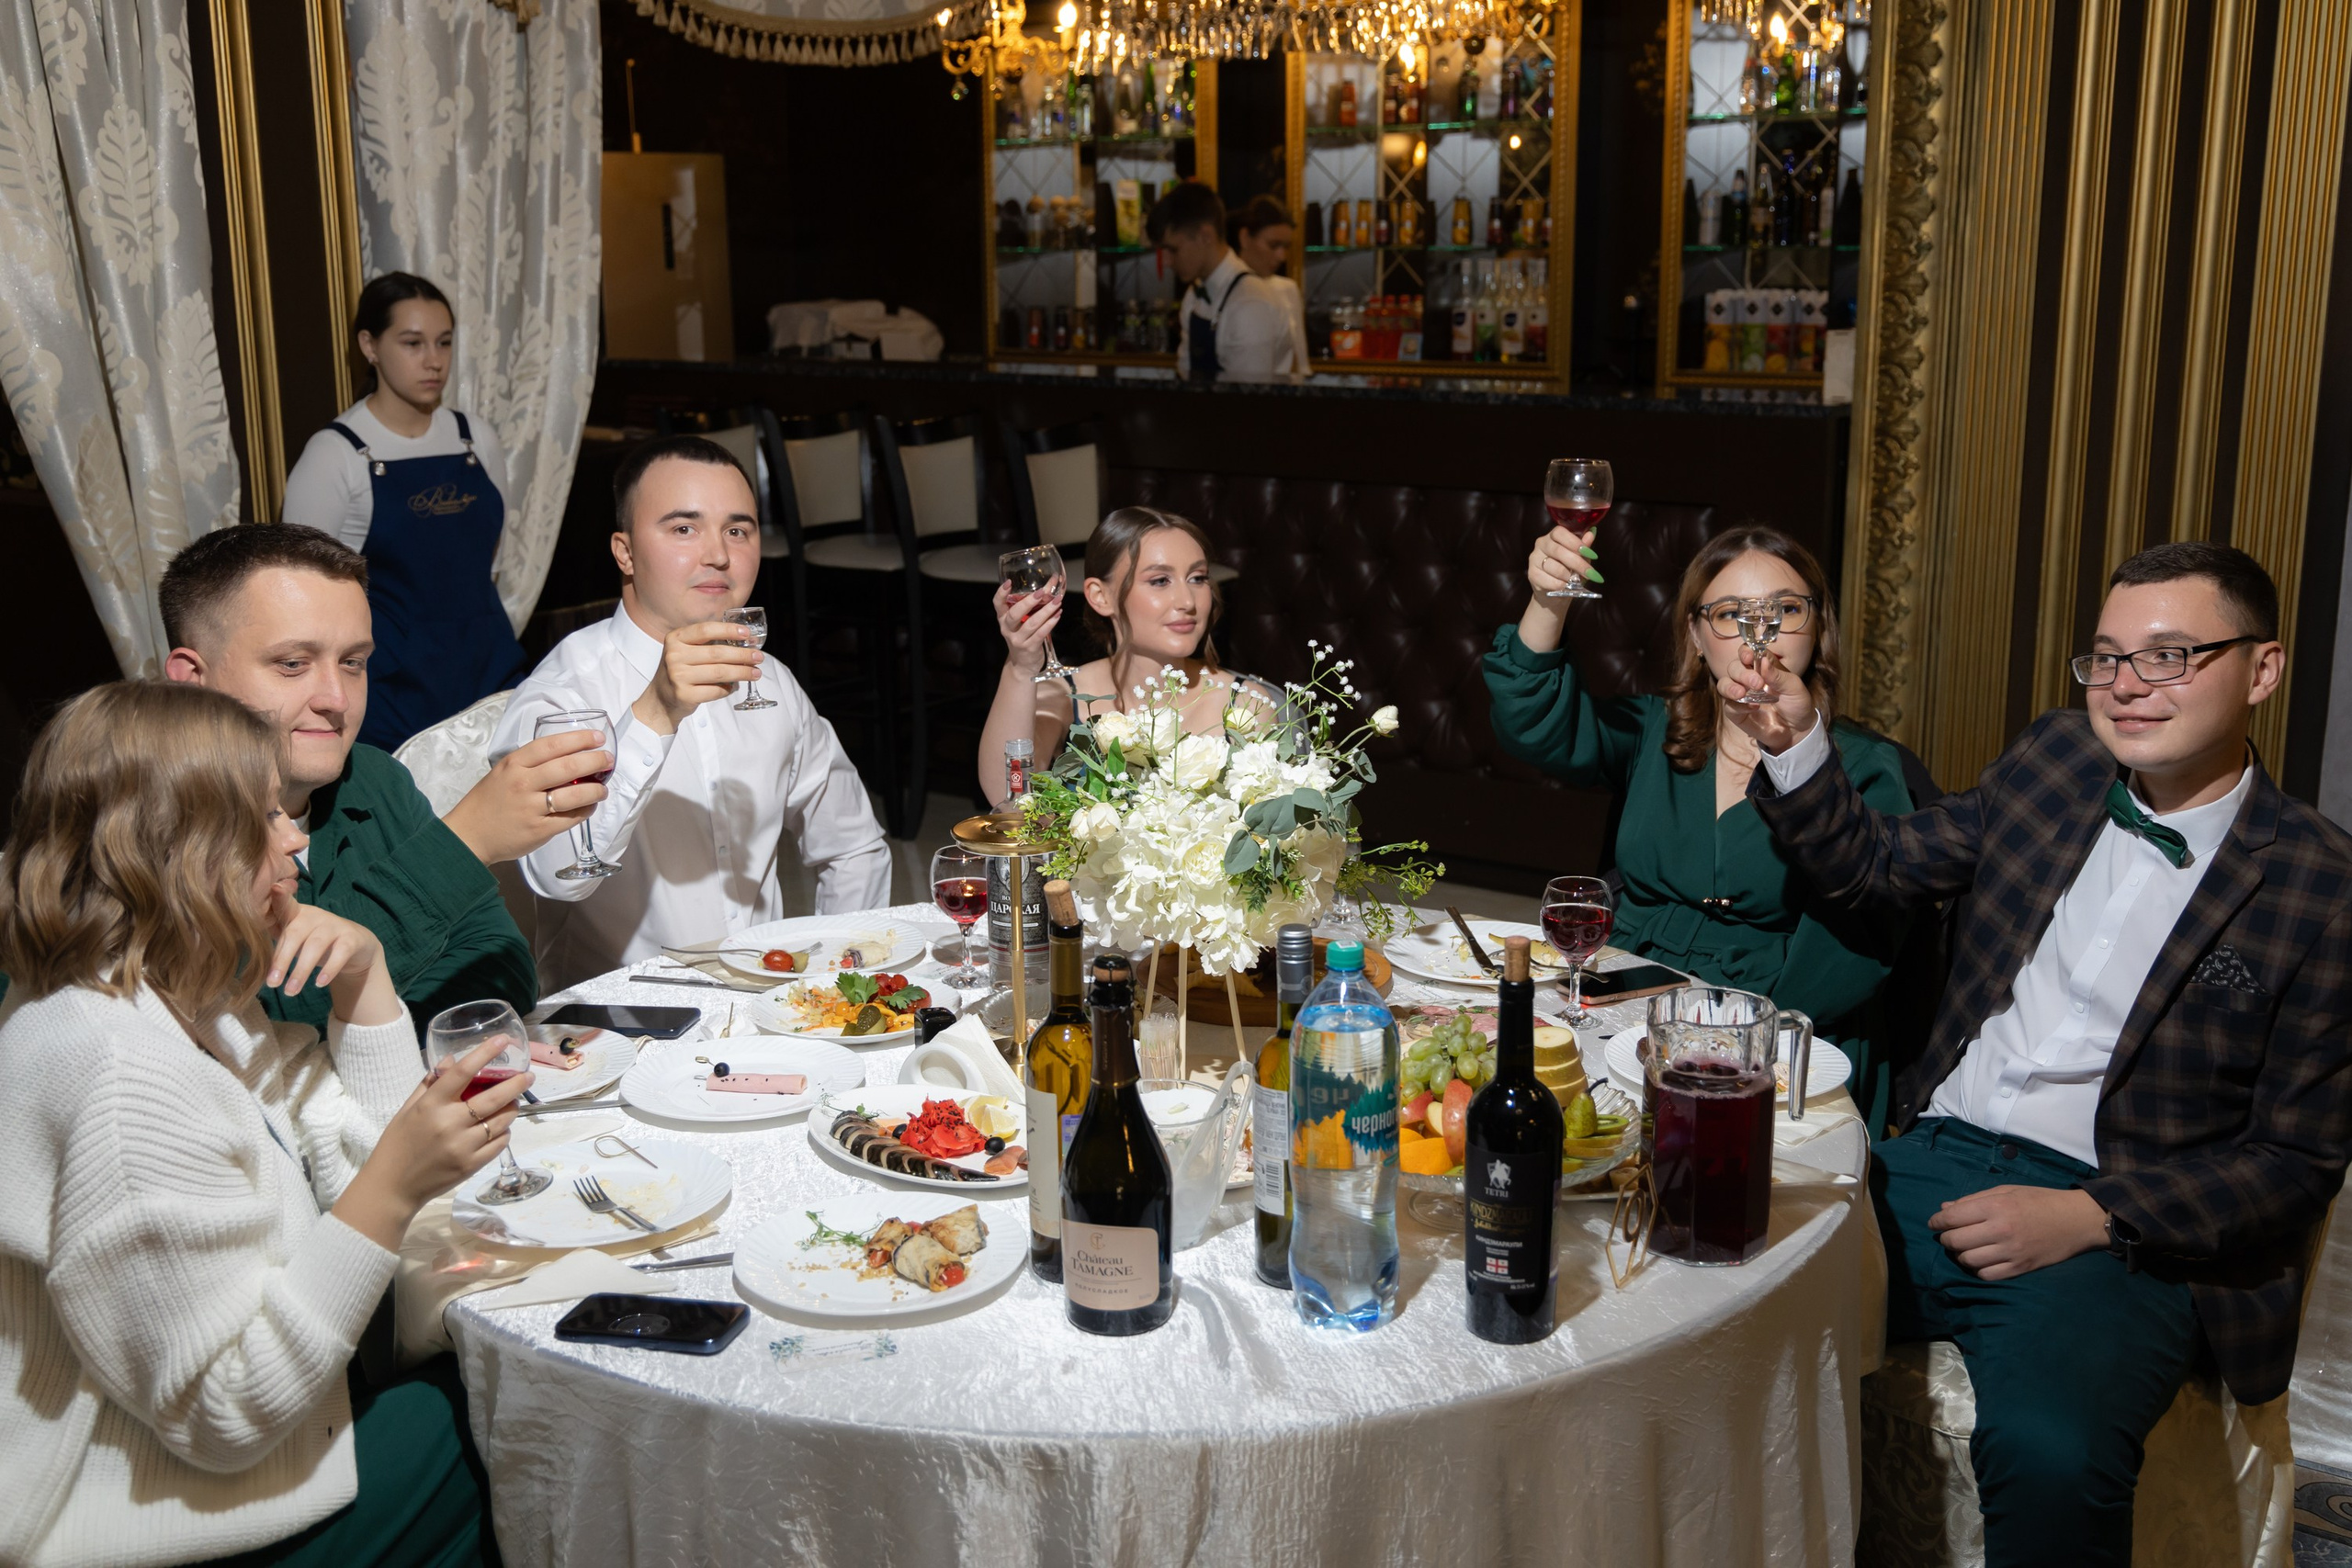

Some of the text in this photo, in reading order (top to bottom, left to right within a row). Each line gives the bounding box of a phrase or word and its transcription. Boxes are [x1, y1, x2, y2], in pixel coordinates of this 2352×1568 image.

[1484, 1187, 1509, 1198] TETRI
[1077, 1249, 1123, 1265] Château
[1070, 1257, 1134, 1277] TAMAGNE
[1074, 1282, 1128, 1294] ПОЛУСЛАДКОЕ
